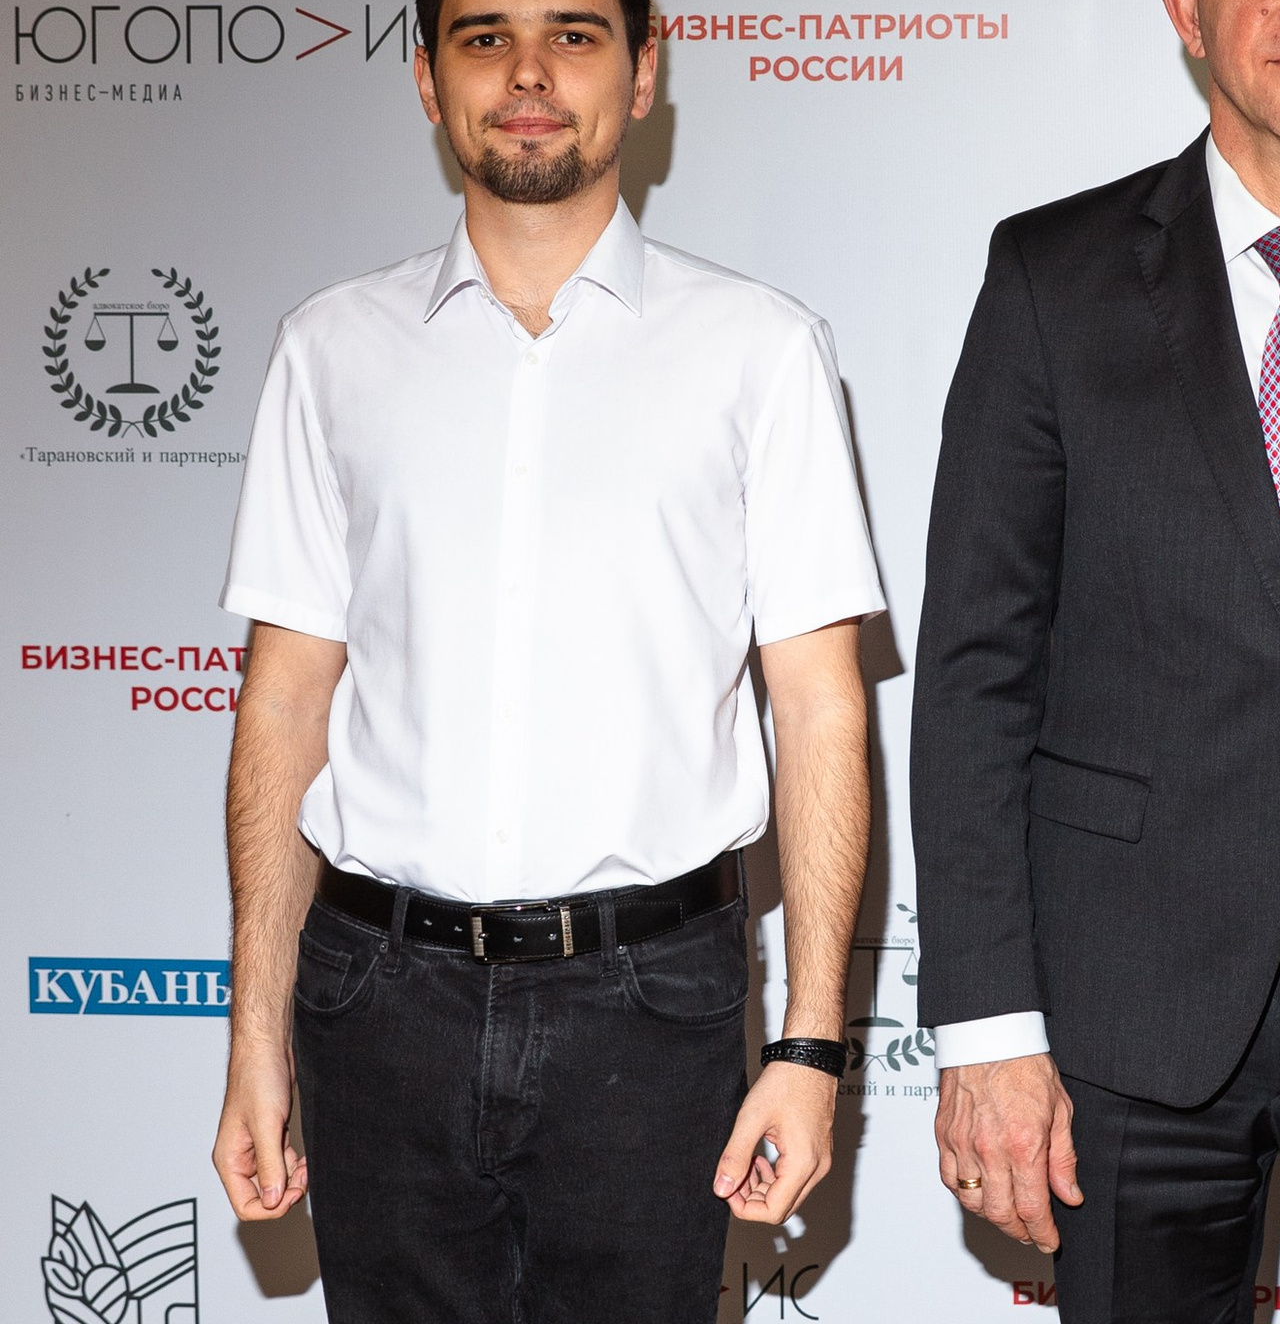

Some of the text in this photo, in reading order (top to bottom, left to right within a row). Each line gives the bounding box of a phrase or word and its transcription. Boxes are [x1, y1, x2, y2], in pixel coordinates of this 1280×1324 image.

[750, 55, 903, 81] РОССИИ
[15, 83, 183, 104] БИЗНЕС-МЕДИА
[20, 447, 135, 467] «Тарановский
[142, 450, 152, 463] и
[21, 645, 248, 671] БИЗНЕС-ПАТ
[131, 686, 236, 711] РОСС
[886, 1084, 895, 1096] и
[903, 1084, 941, 1101] парт
